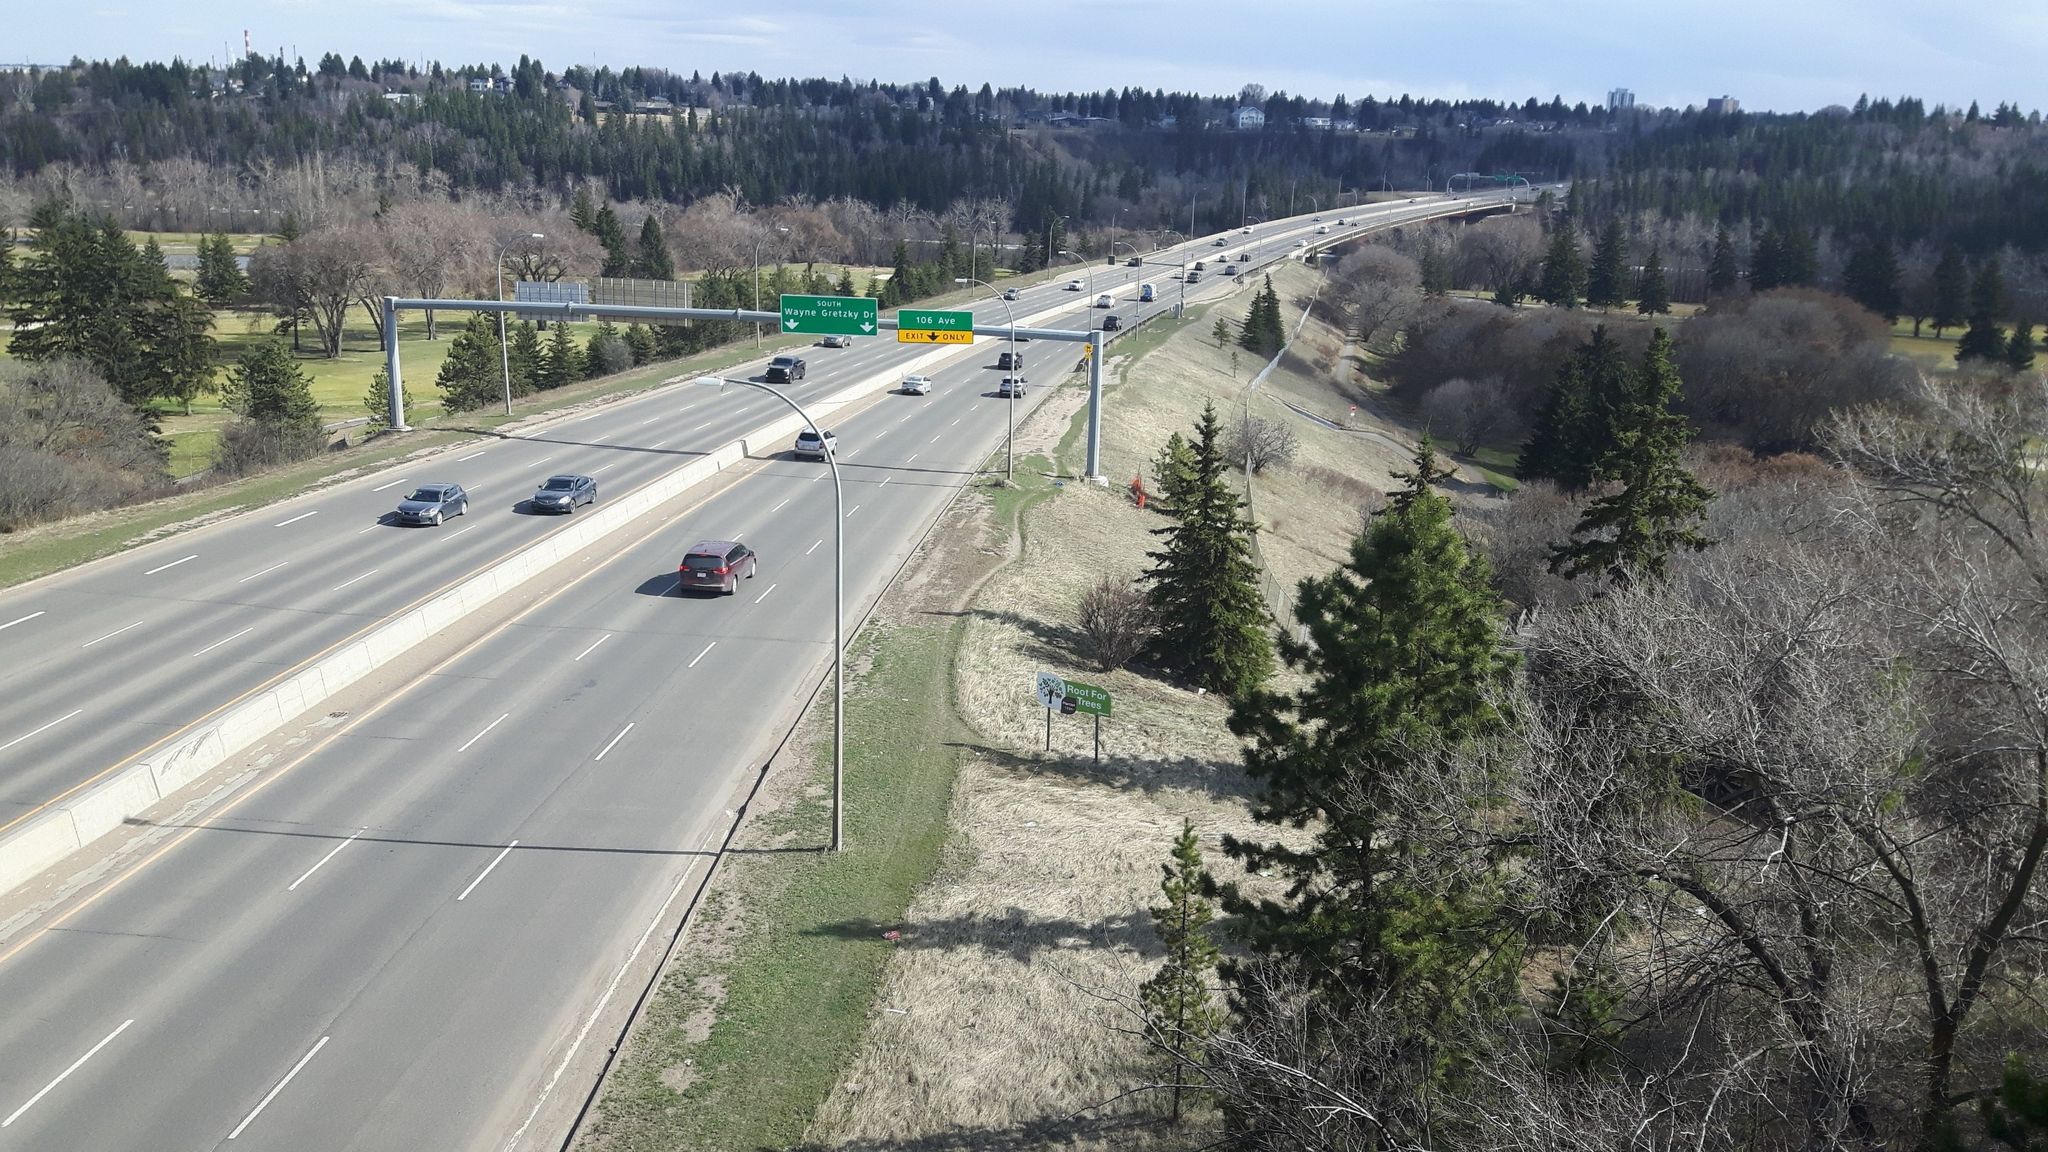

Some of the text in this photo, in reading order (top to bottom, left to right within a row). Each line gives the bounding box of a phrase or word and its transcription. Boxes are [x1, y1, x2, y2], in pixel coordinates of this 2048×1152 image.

[784, 308, 816, 317] Wayne
[821, 309, 859, 319] Gretzky
[916, 316, 933, 324] 106
[1067, 684, 1107, 700] Root For
[1076, 696, 1102, 710] Trees
